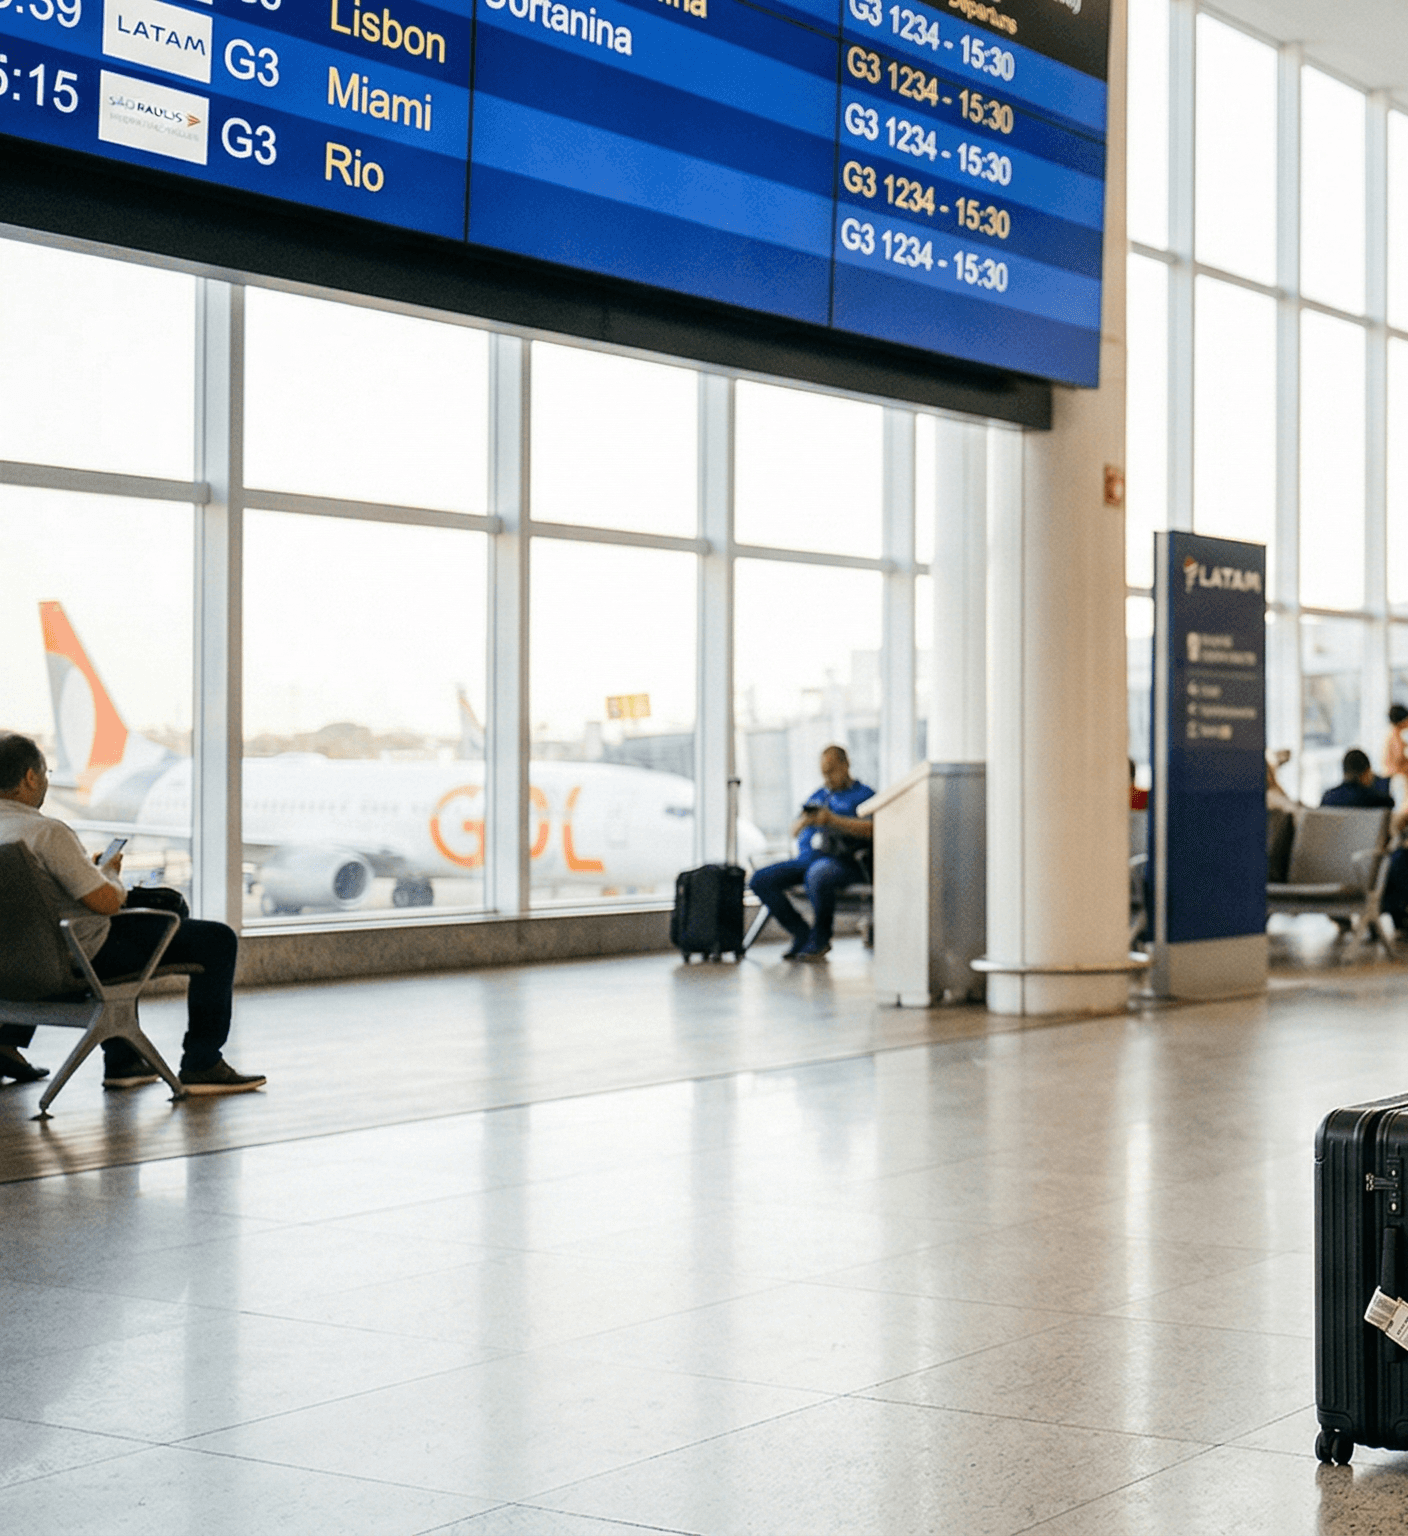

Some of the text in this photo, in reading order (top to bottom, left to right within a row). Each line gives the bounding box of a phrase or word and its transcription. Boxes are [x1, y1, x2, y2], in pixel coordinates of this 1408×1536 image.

[331, 0, 446, 64] Lisbon
[484, 0, 633, 56] ortanina
[849, 0, 883, 26] G3
[889, 5, 941, 50] 1234
[960, 34, 1015, 82] 15:30
[117, 15, 432, 131] LATAM G3 Miami
[847, 46, 881, 84] G3
[888, 61, 939, 107] 1234
[959, 88, 1014, 134] 15:30
[221, 118, 277, 165] G3
[325, 142, 385, 193] Rio
[844, 102, 880, 141] G3
[886, 116, 937, 161] 1234
[957, 142, 1012, 186] 15:30
[843, 161, 877, 198] G3
[884, 174, 935, 216] 1234
[956, 197, 1011, 240] 15:30
[841, 217, 875, 255] G3
[882, 229, 934, 271] 1234
[953, 250, 1009, 292] 15:30
